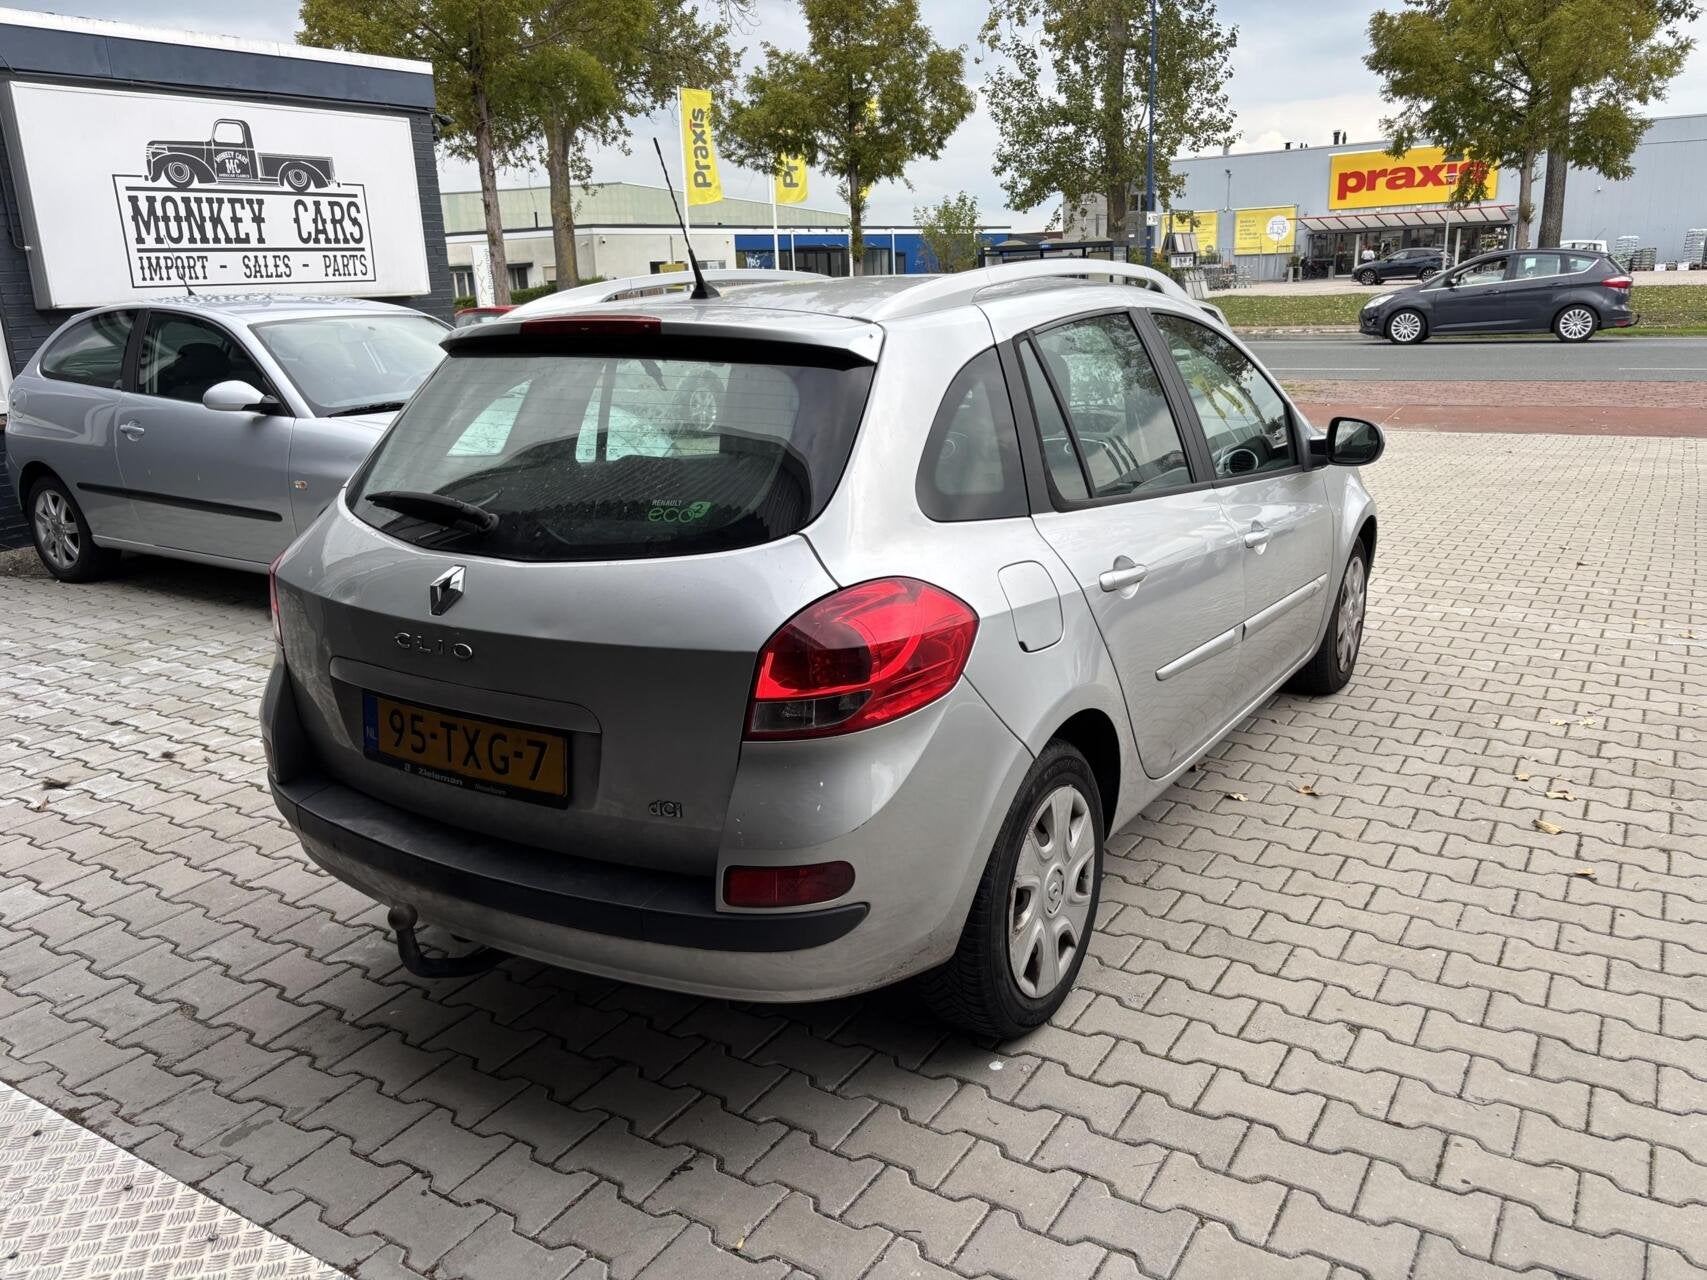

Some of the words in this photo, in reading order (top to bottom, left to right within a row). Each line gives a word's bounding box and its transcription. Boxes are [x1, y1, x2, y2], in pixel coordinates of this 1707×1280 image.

[690, 108, 712, 188] praxis
[127, 195, 266, 245] MONKEY
[293, 198, 364, 245] CARS
[139, 255, 208, 282] IMPORT
[242, 254, 292, 279] SALES
[322, 254, 368, 278] PARTS
[651, 499, 682, 507] RENAULT
[394, 632, 473, 660] CLIO
[366, 725, 378, 741] NL
[387, 708, 549, 781] 95-TXG-7
